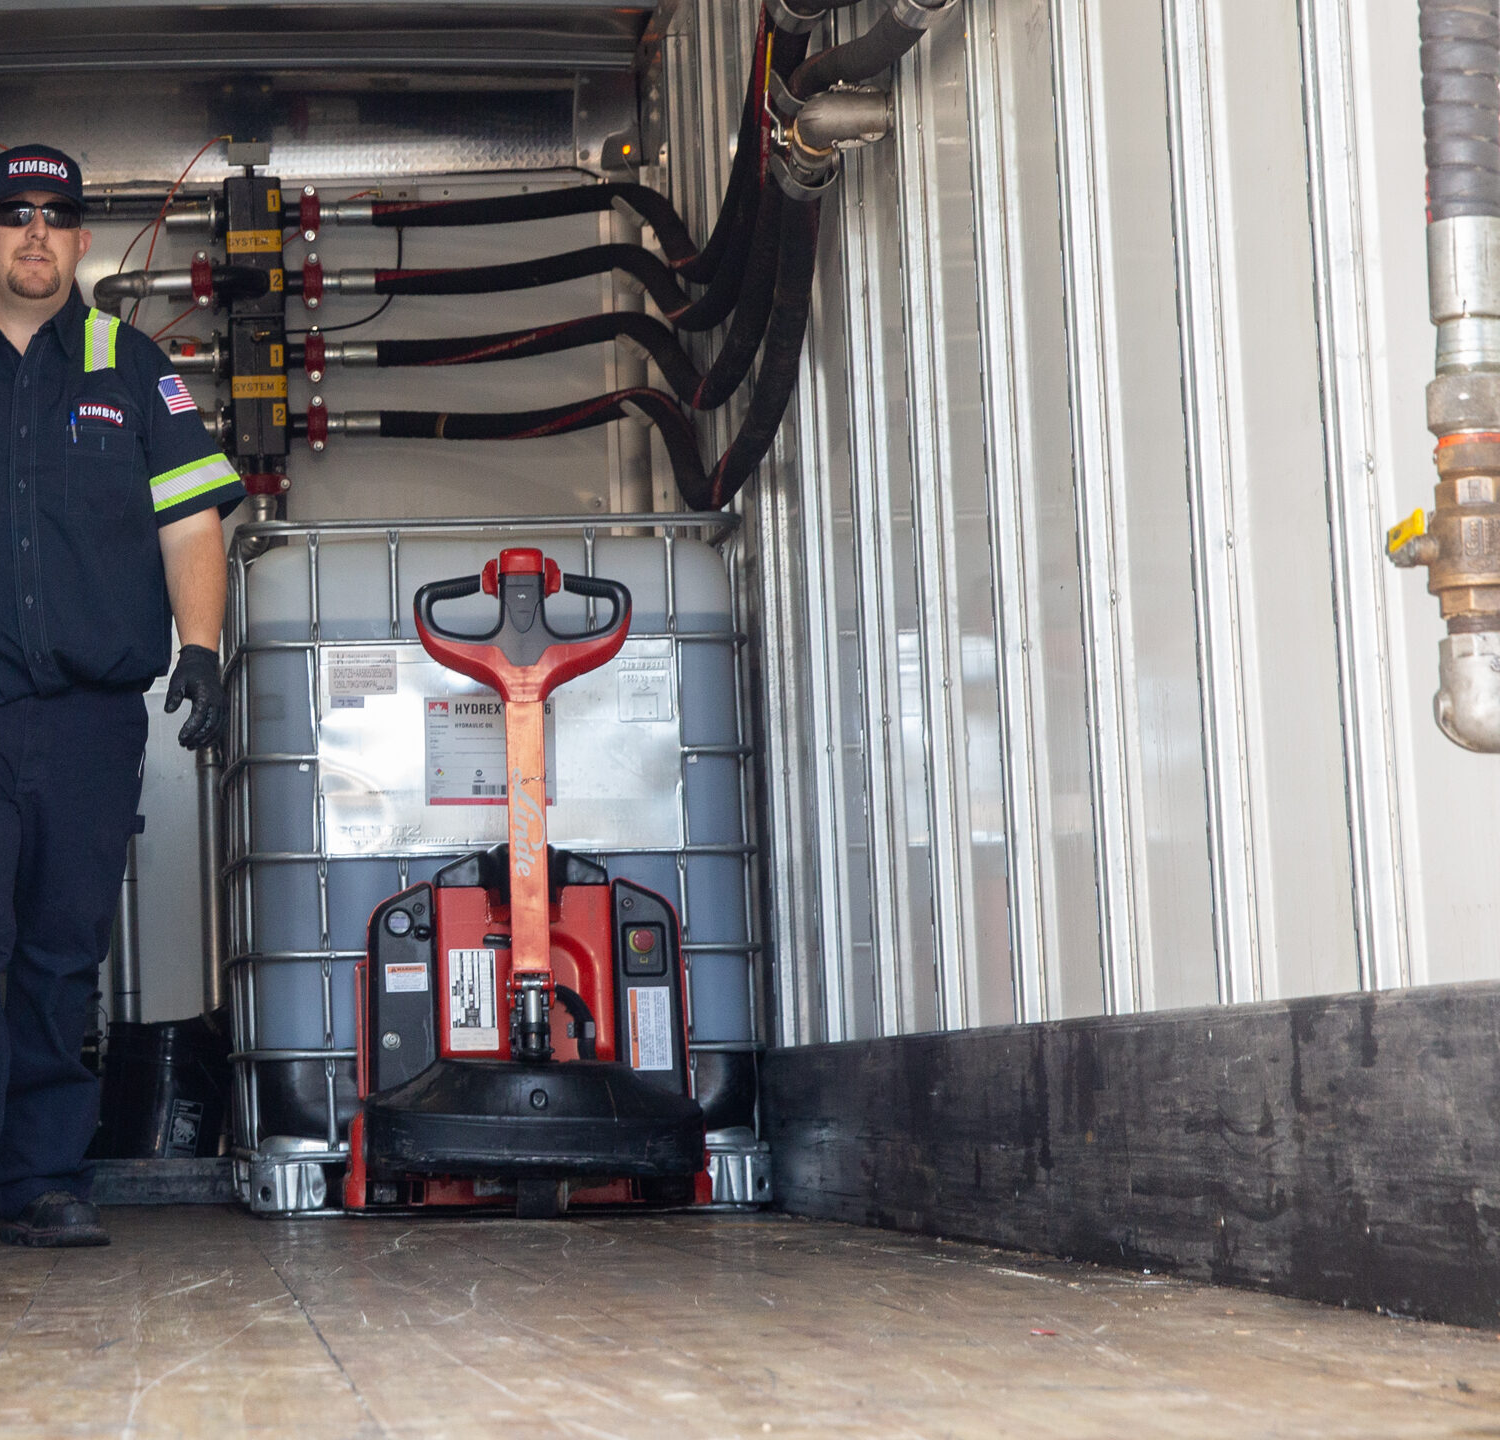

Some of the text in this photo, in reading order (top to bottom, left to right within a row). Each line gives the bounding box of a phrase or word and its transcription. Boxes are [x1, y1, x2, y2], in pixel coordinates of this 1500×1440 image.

[271, 194, 277, 208] 1
[228, 237, 269, 247] SYSTEM
[273, 273, 281, 287] 2
[274, 349, 279, 363] 1
[234, 382, 275, 392] SYSTEM
[276, 408, 284, 421] 2
[512, 767, 546, 877] Linde
